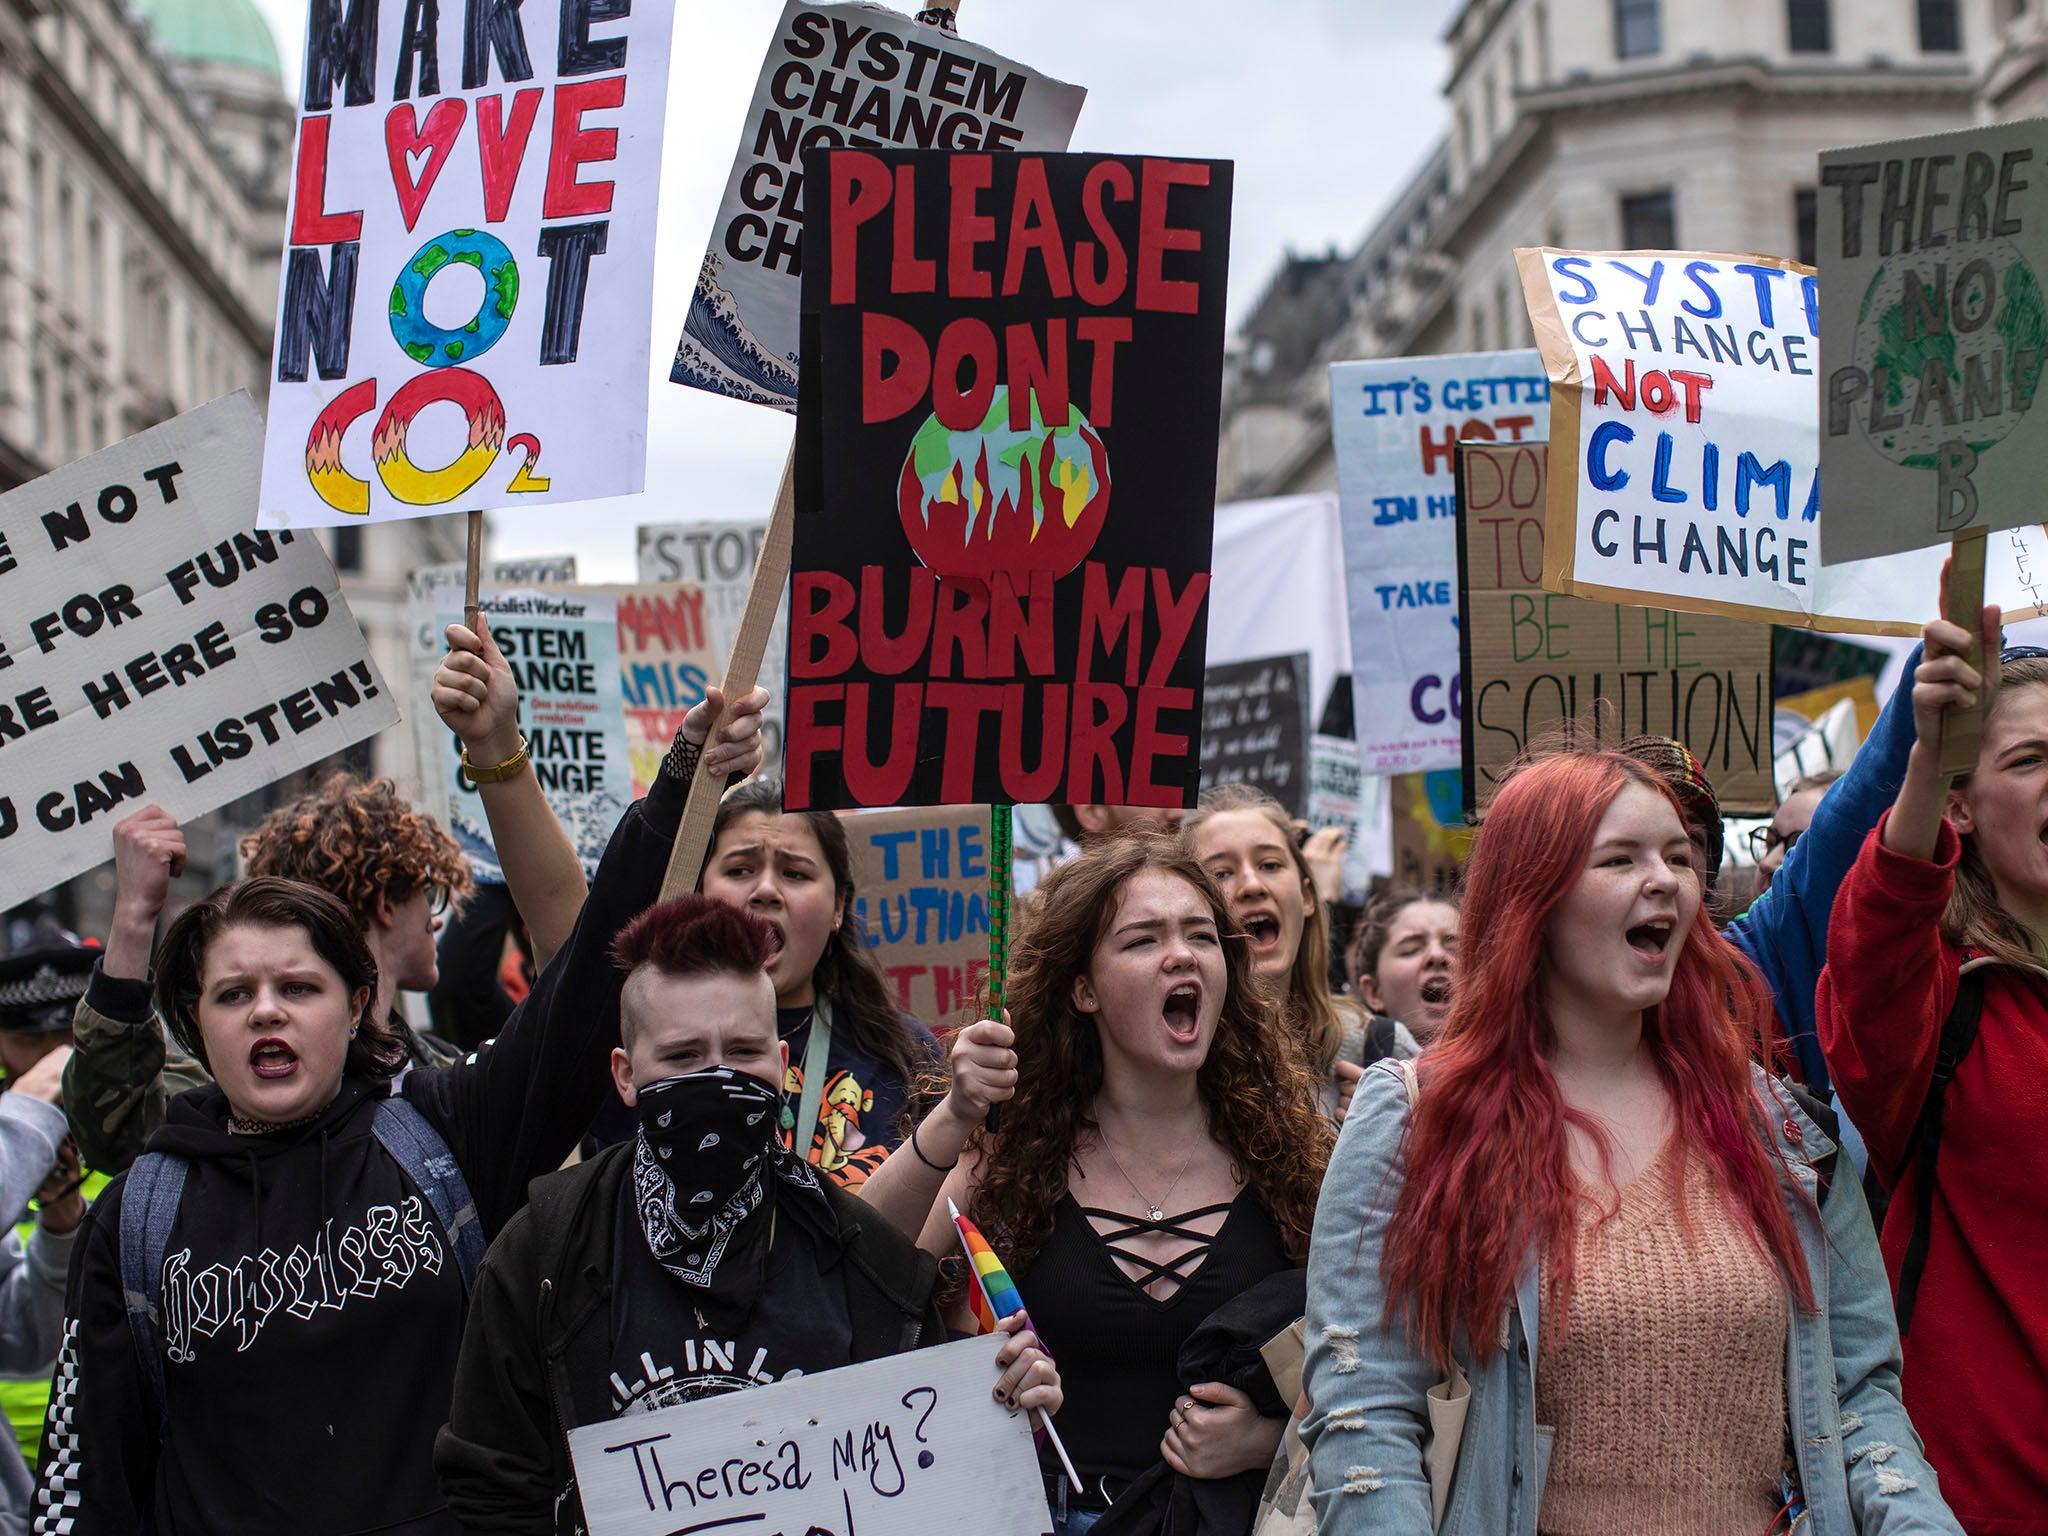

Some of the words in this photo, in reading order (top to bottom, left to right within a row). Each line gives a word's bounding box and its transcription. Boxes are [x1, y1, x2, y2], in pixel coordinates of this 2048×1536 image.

[305, 0, 631, 111] MAKE
[783, 12, 1027, 123] SYSTEM
[829, 152, 1209, 314] PLEASE
[278, 220, 611, 382] NOT
[1904, 258, 1995, 341] NO
[862, 312, 1133, 432] DONT
[1572, 309, 1813, 375] CHANGE
[1363, 376, 1432, 416] IT'S
[1443, 377, 1550, 411] GETTI
[1590, 354, 1714, 424] NOT
[1829, 343, 2048, 436] PLANE
[41, 462, 183, 552] NOT
[1373, 496, 1418, 525] IN
[1467, 446, 1549, 510] DO
[1936, 440, 1979, 532] B
[1479, 517, 1544, 588] TO
[1592, 509, 1806, 585] CHANGE
[30, 583, 142, 653] FOR
[478, 597, 533, 615] ocialist
[791, 565, 1055, 679] BURN
[1076, 561, 1211, 687] MY
[1374, 581, 1451, 611] TAKE
[1511, 594, 1570, 664] BE
[82, 621, 236, 719] HERE
[255, 586, 329, 646] SO
[447, 626, 587, 660] STEM
[512, 662, 597, 694] ANGE
[36, 761, 147, 832] CAN
[169, 660, 379, 784] LISTEN!
[784, 681, 1194, 809] FUTURE
[871, 826, 986, 880] THE
[855, 888, 990, 948] LUTION
[685, 1340, 735, 1372] IN
[604, 1433, 812, 1511] Theresa
